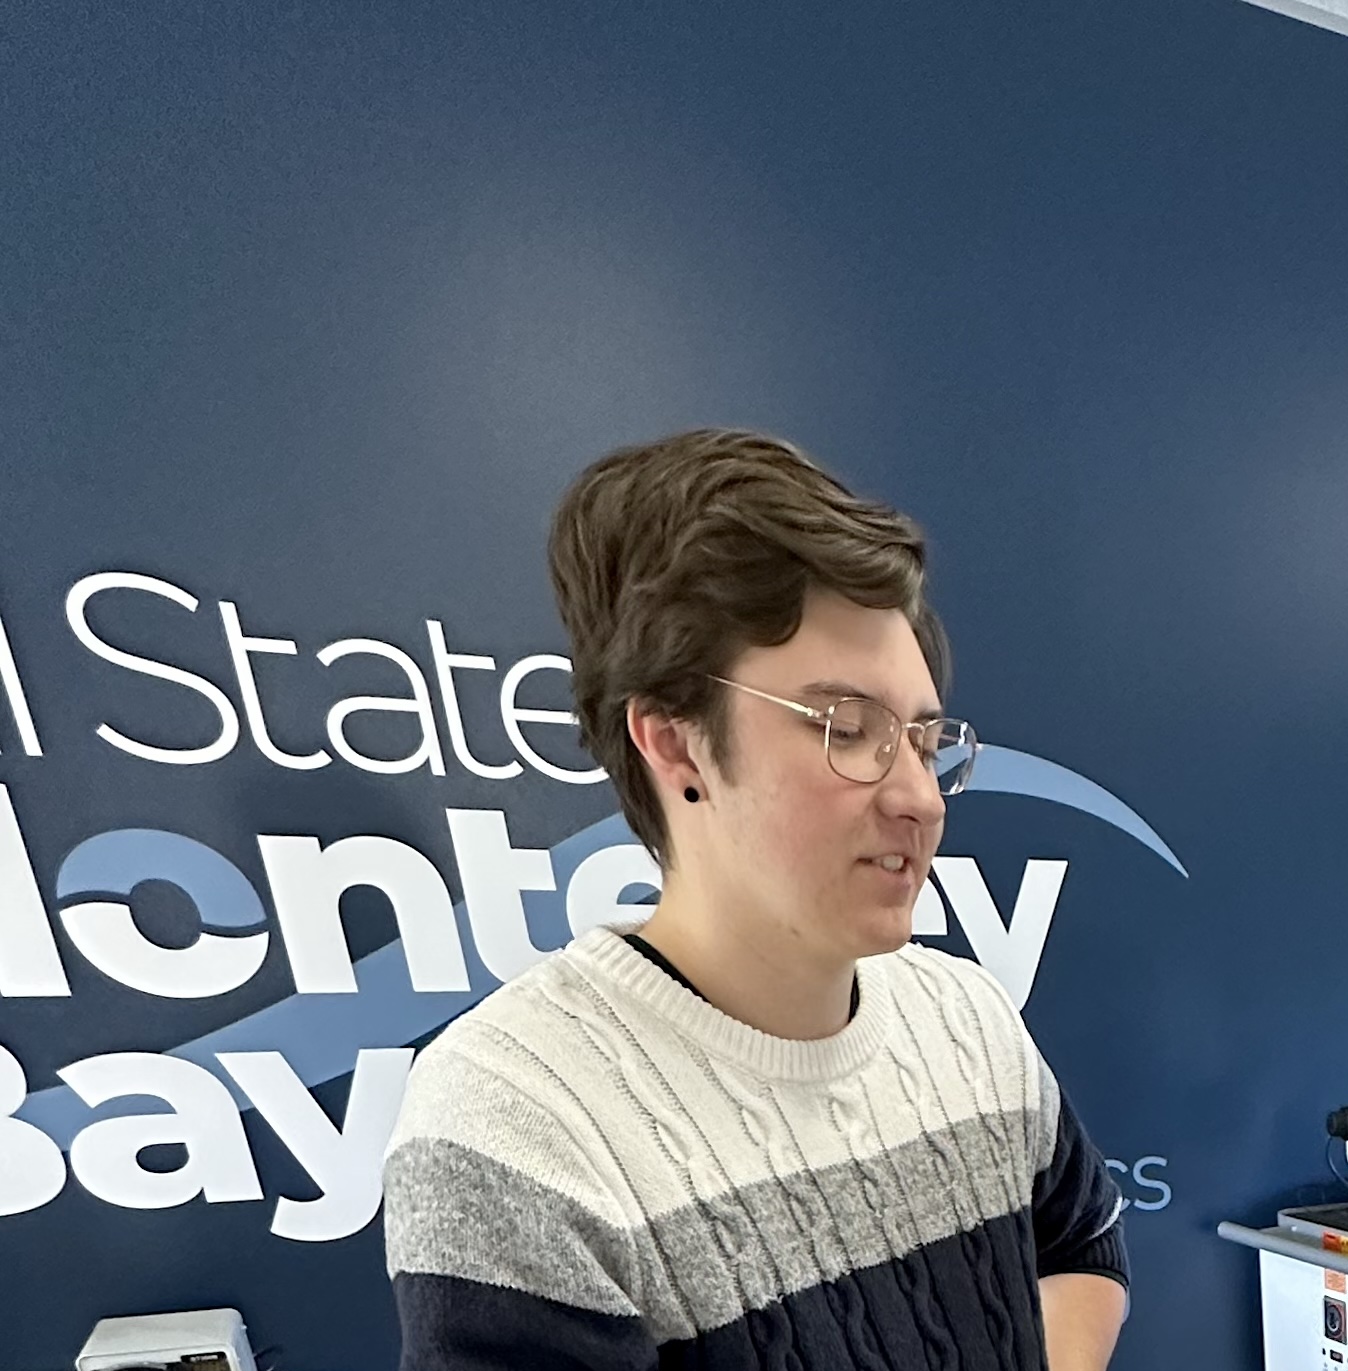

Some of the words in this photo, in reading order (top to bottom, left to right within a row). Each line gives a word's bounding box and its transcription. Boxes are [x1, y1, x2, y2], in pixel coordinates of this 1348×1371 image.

[66, 571, 609, 785] State
[0, 783, 1068, 1011] ontey
[0, 1040, 414, 1242] ay
